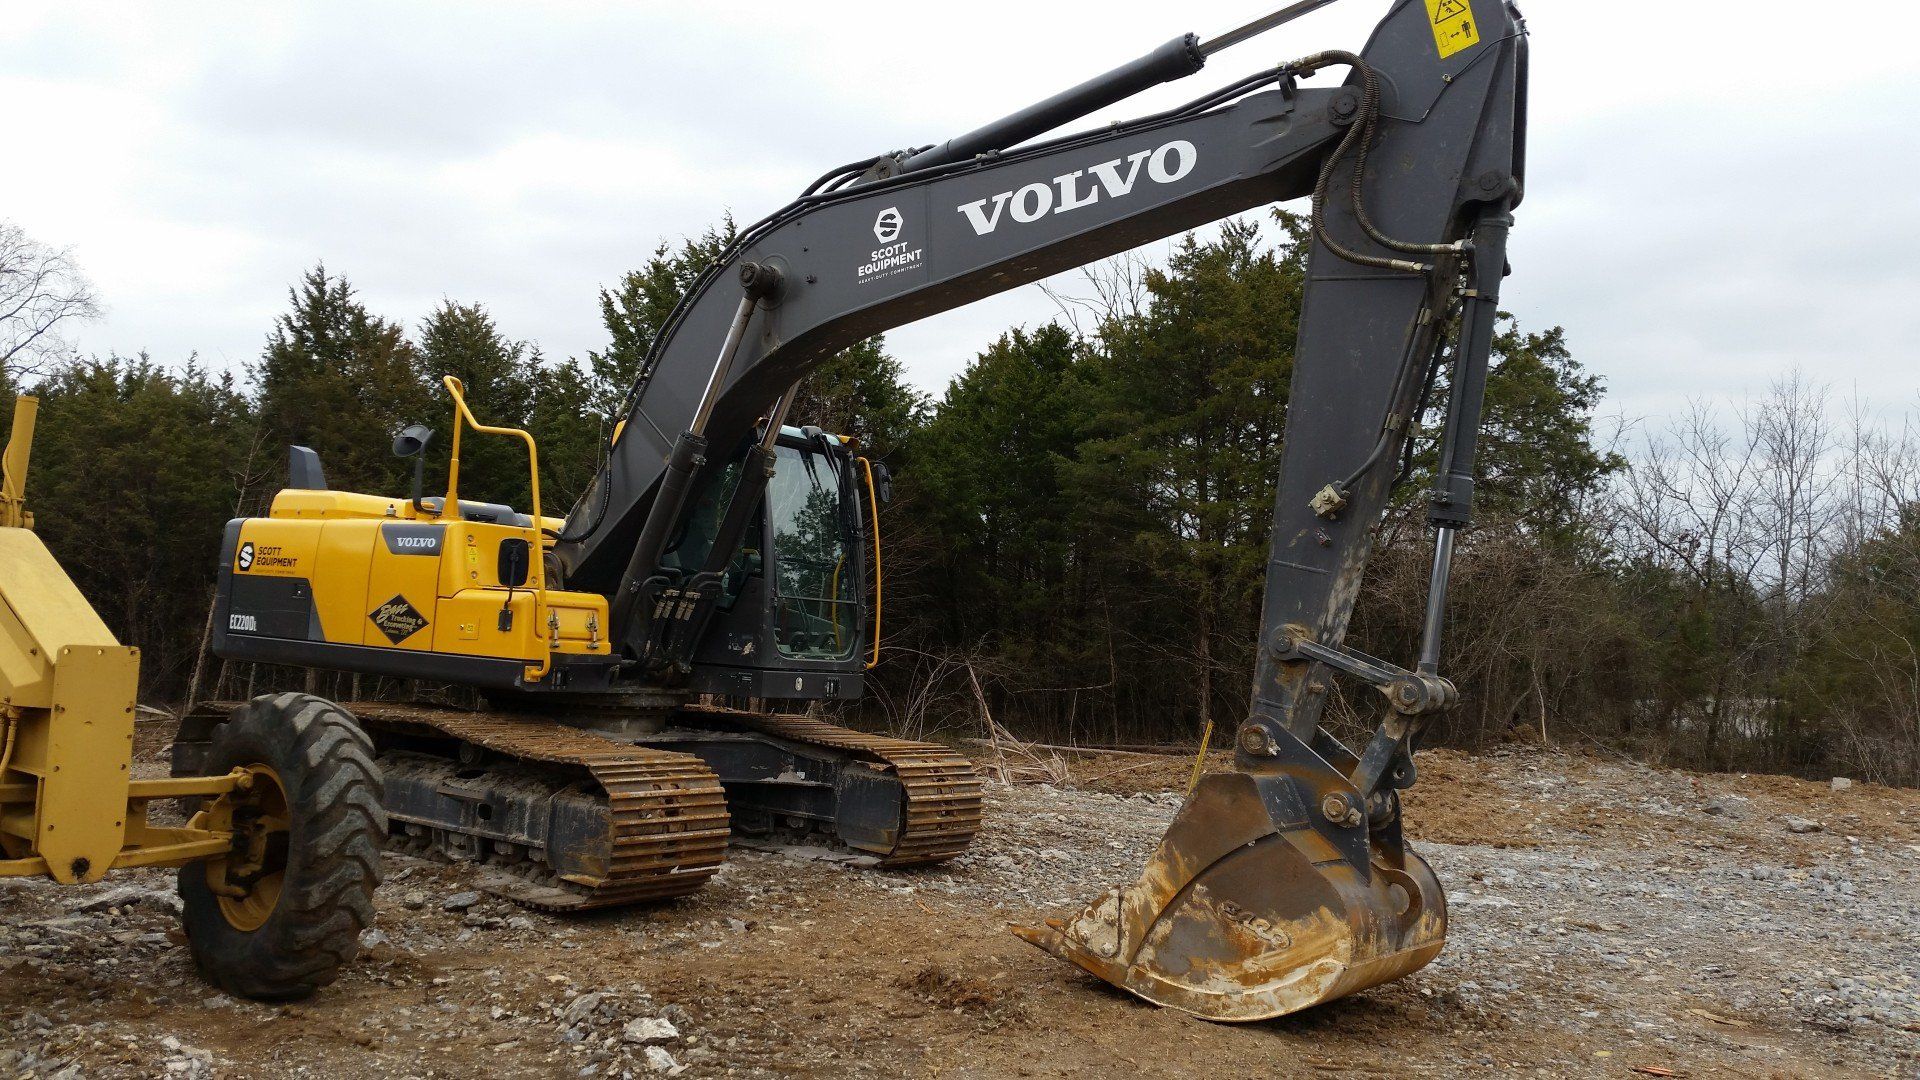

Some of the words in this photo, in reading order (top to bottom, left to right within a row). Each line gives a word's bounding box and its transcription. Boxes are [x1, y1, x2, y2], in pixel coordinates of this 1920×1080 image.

[957, 140, 1197, 236] VOLVO
[871, 241, 908, 262] SCOTT
[858, 249, 922, 277] EQUIPMENT
[396, 537, 436, 548] VOLVO
[258, 546, 282, 556] SCOTT
[256, 556, 298, 567] EQUIPMENT
